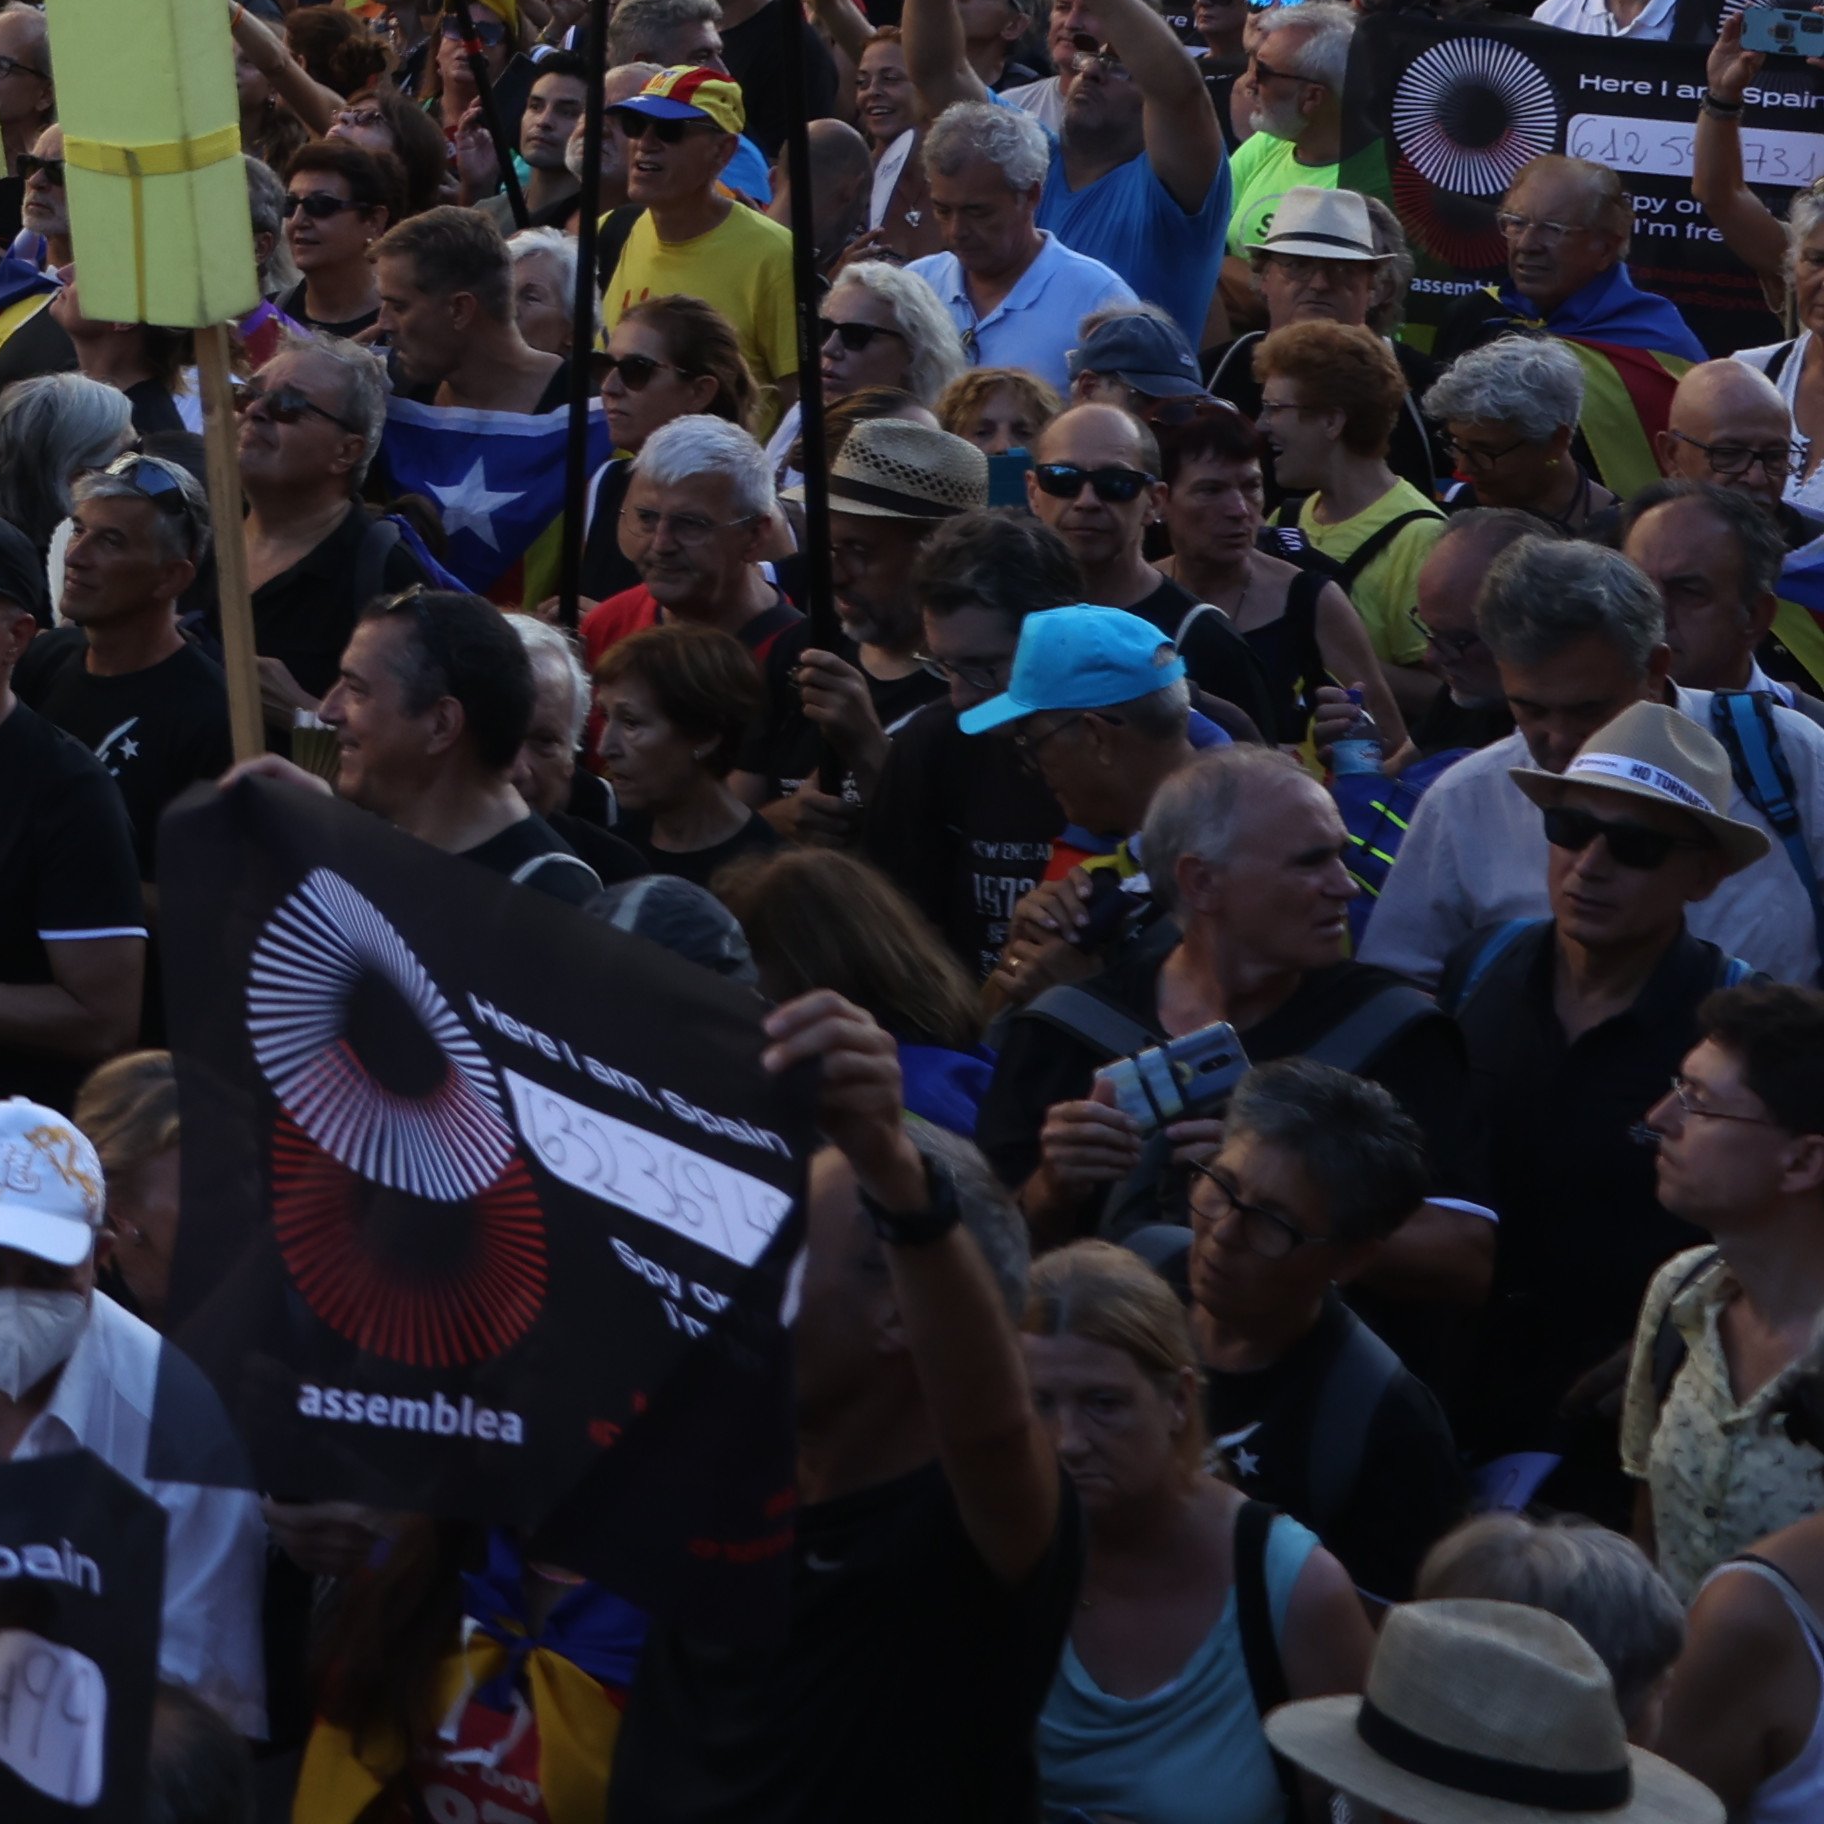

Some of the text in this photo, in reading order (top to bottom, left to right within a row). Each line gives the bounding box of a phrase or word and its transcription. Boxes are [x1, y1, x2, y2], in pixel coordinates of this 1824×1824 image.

[1579, 74, 1652, 96] Here
[1661, 76, 1666, 95] I
[1572, 118, 1649, 165] 612
[1634, 217, 1677, 238] I'm
[465, 991, 562, 1062] Here
[559, 1039, 581, 1070] I
[656, 1086, 794, 1160] Spain
[608, 1236, 683, 1299] Spy
[298, 1382, 524, 1445] assemblea
